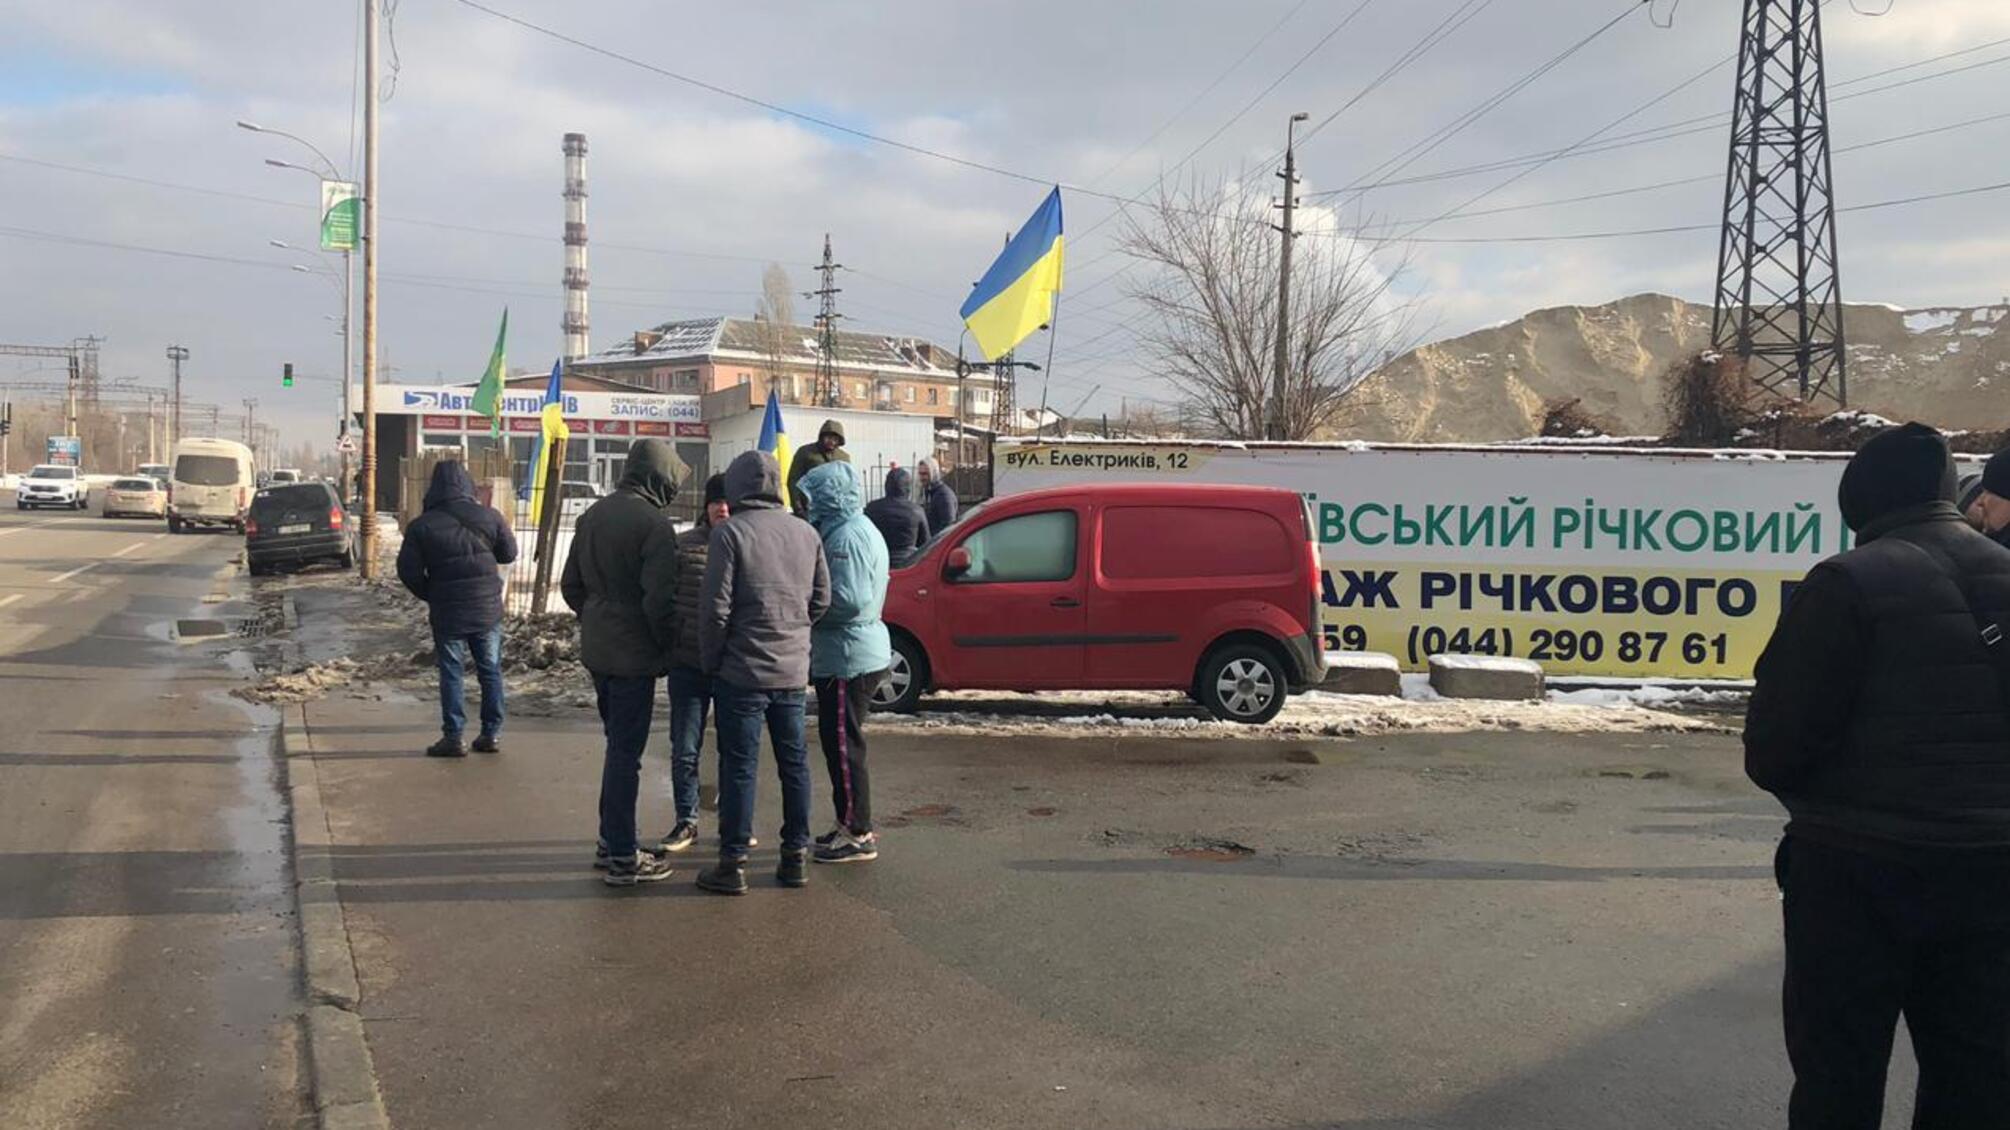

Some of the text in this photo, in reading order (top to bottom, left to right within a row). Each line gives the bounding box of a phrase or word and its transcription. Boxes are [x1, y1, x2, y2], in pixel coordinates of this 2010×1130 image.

[611, 404, 700, 418] ЗАПИС: (044)
[1007, 450, 1188, 470] вул. Електриків, 12
[1420, 571, 1757, 617] РІЧКОВОГО
[1407, 625, 1513, 664] (044)
[1528, 629, 1604, 662] 290
[1618, 631, 1668, 663] 87
[1682, 632, 1727, 664] 61
